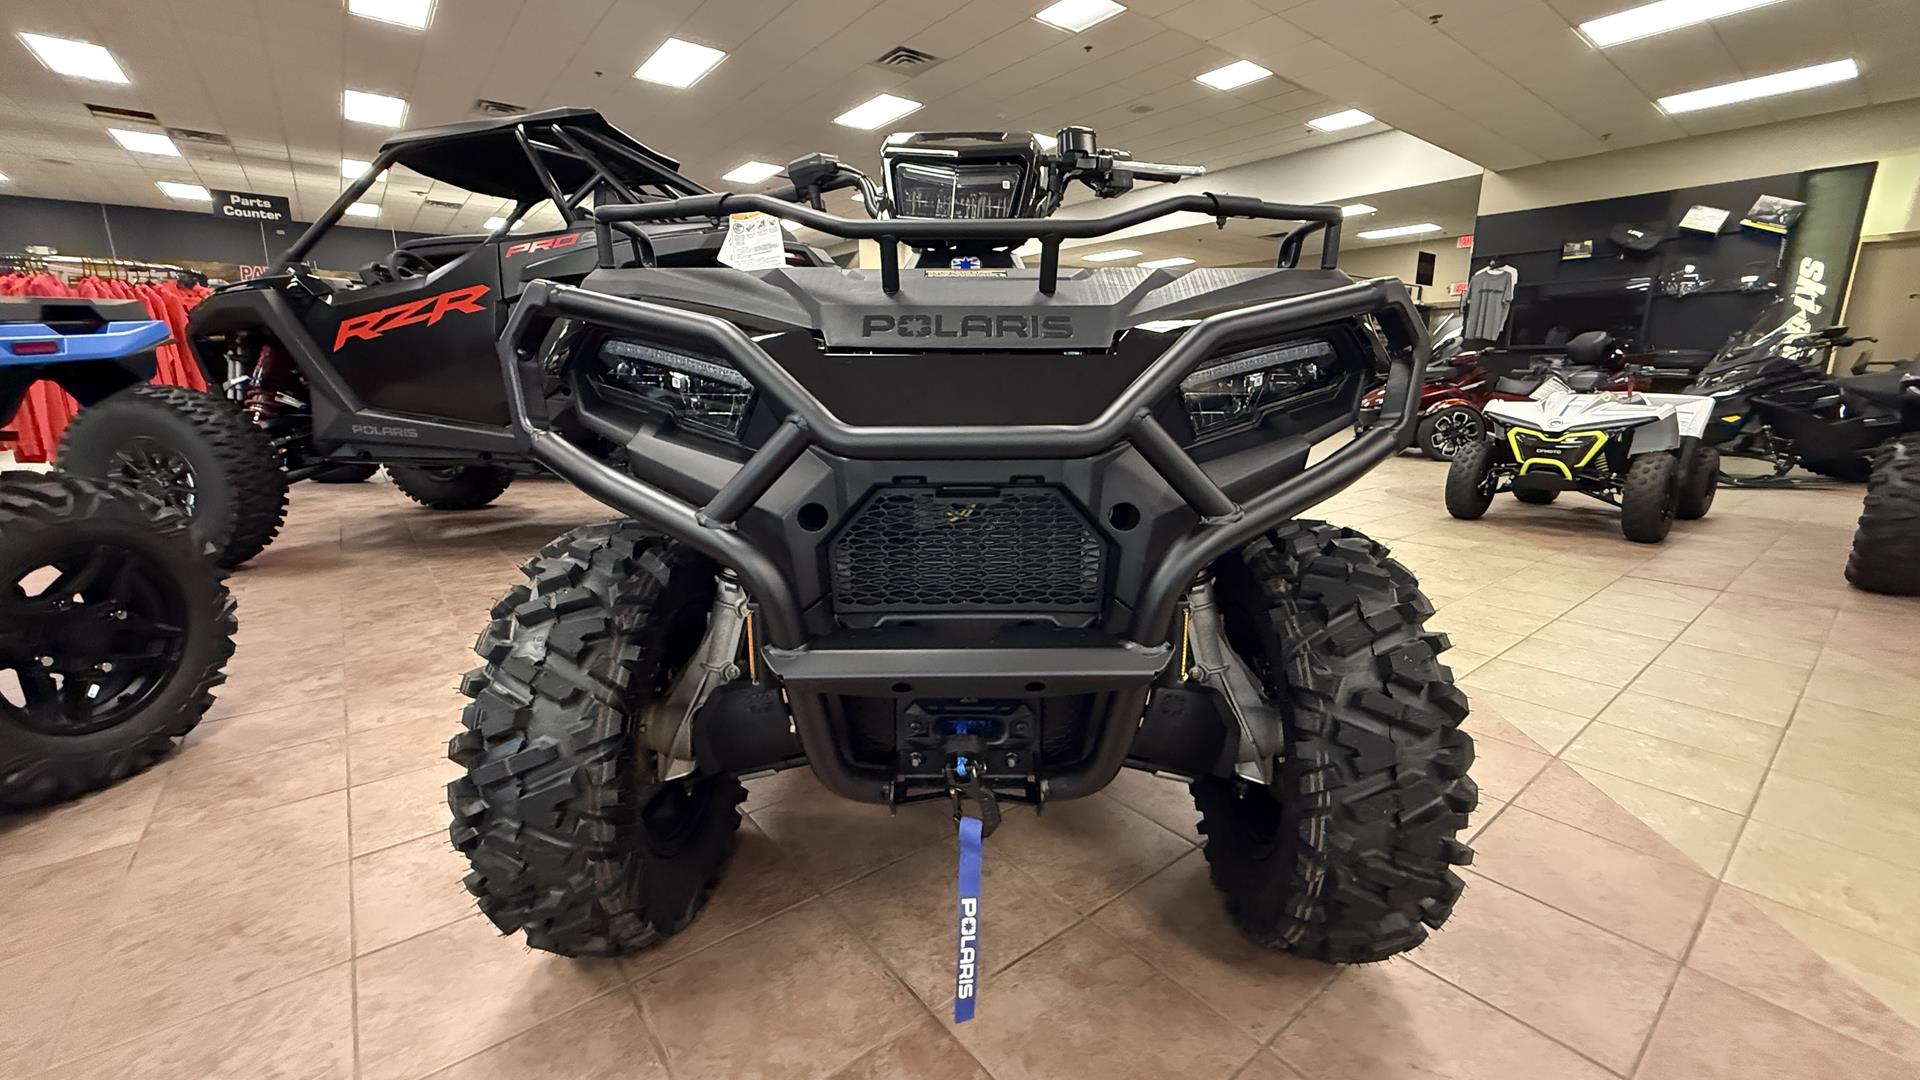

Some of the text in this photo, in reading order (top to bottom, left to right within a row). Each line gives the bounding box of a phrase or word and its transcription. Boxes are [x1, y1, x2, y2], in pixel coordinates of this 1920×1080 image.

[223, 205, 282, 220] Counter
[230, 194, 272, 208] Parts
[505, 232, 581, 258] PRO
[333, 284, 491, 352] RZR
[862, 314, 1074, 339] POLARIS
[351, 424, 418, 438] POLARIS
[958, 897, 977, 1000] POLARIS
